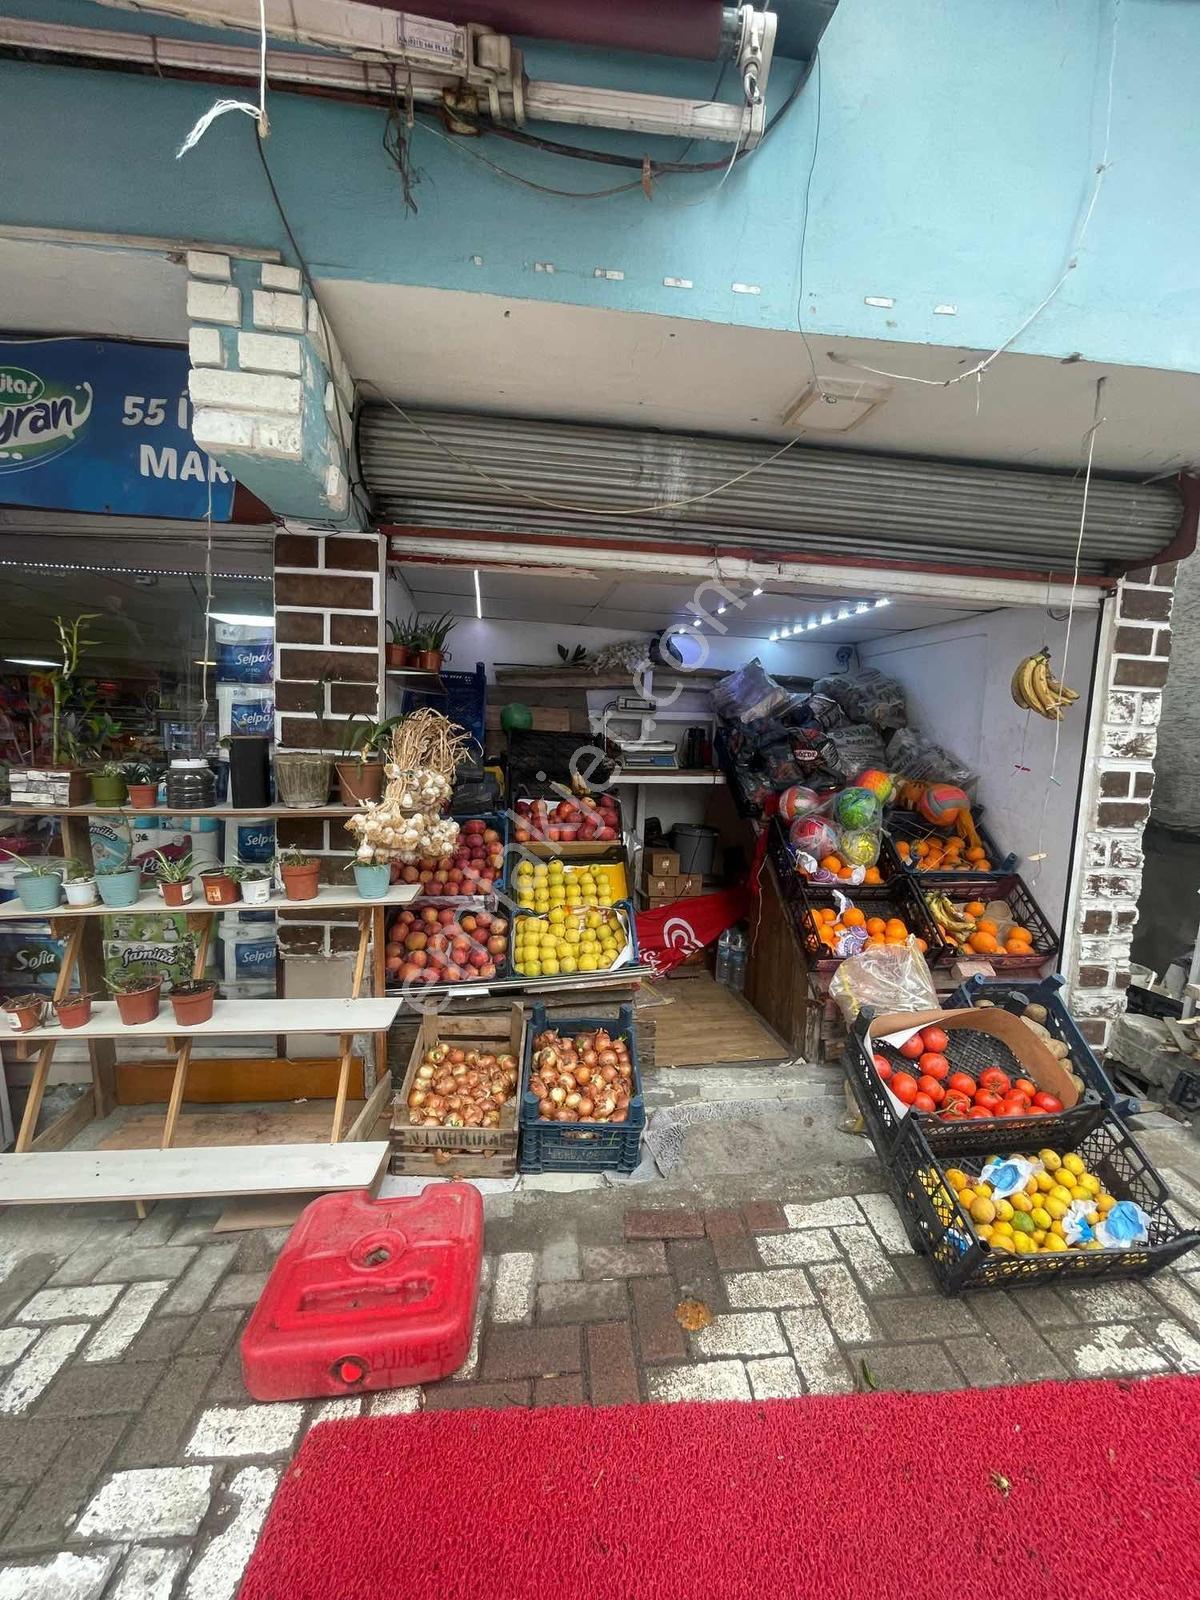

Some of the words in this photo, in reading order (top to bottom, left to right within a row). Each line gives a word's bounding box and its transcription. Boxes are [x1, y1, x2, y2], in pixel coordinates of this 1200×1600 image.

[122, 395, 168, 427] 55
[177, 390, 192, 430] İ
[0, 398, 73, 445] yran
[139, 444, 236, 484] MAR
[235, 652, 273, 666] Selpak
[241, 711, 273, 726] Selpa
[89, 824, 119, 842] milia
[244, 832, 275, 847] Selpa
[13, 950, 56, 972] Sofia
[122, 947, 178, 968] familia
